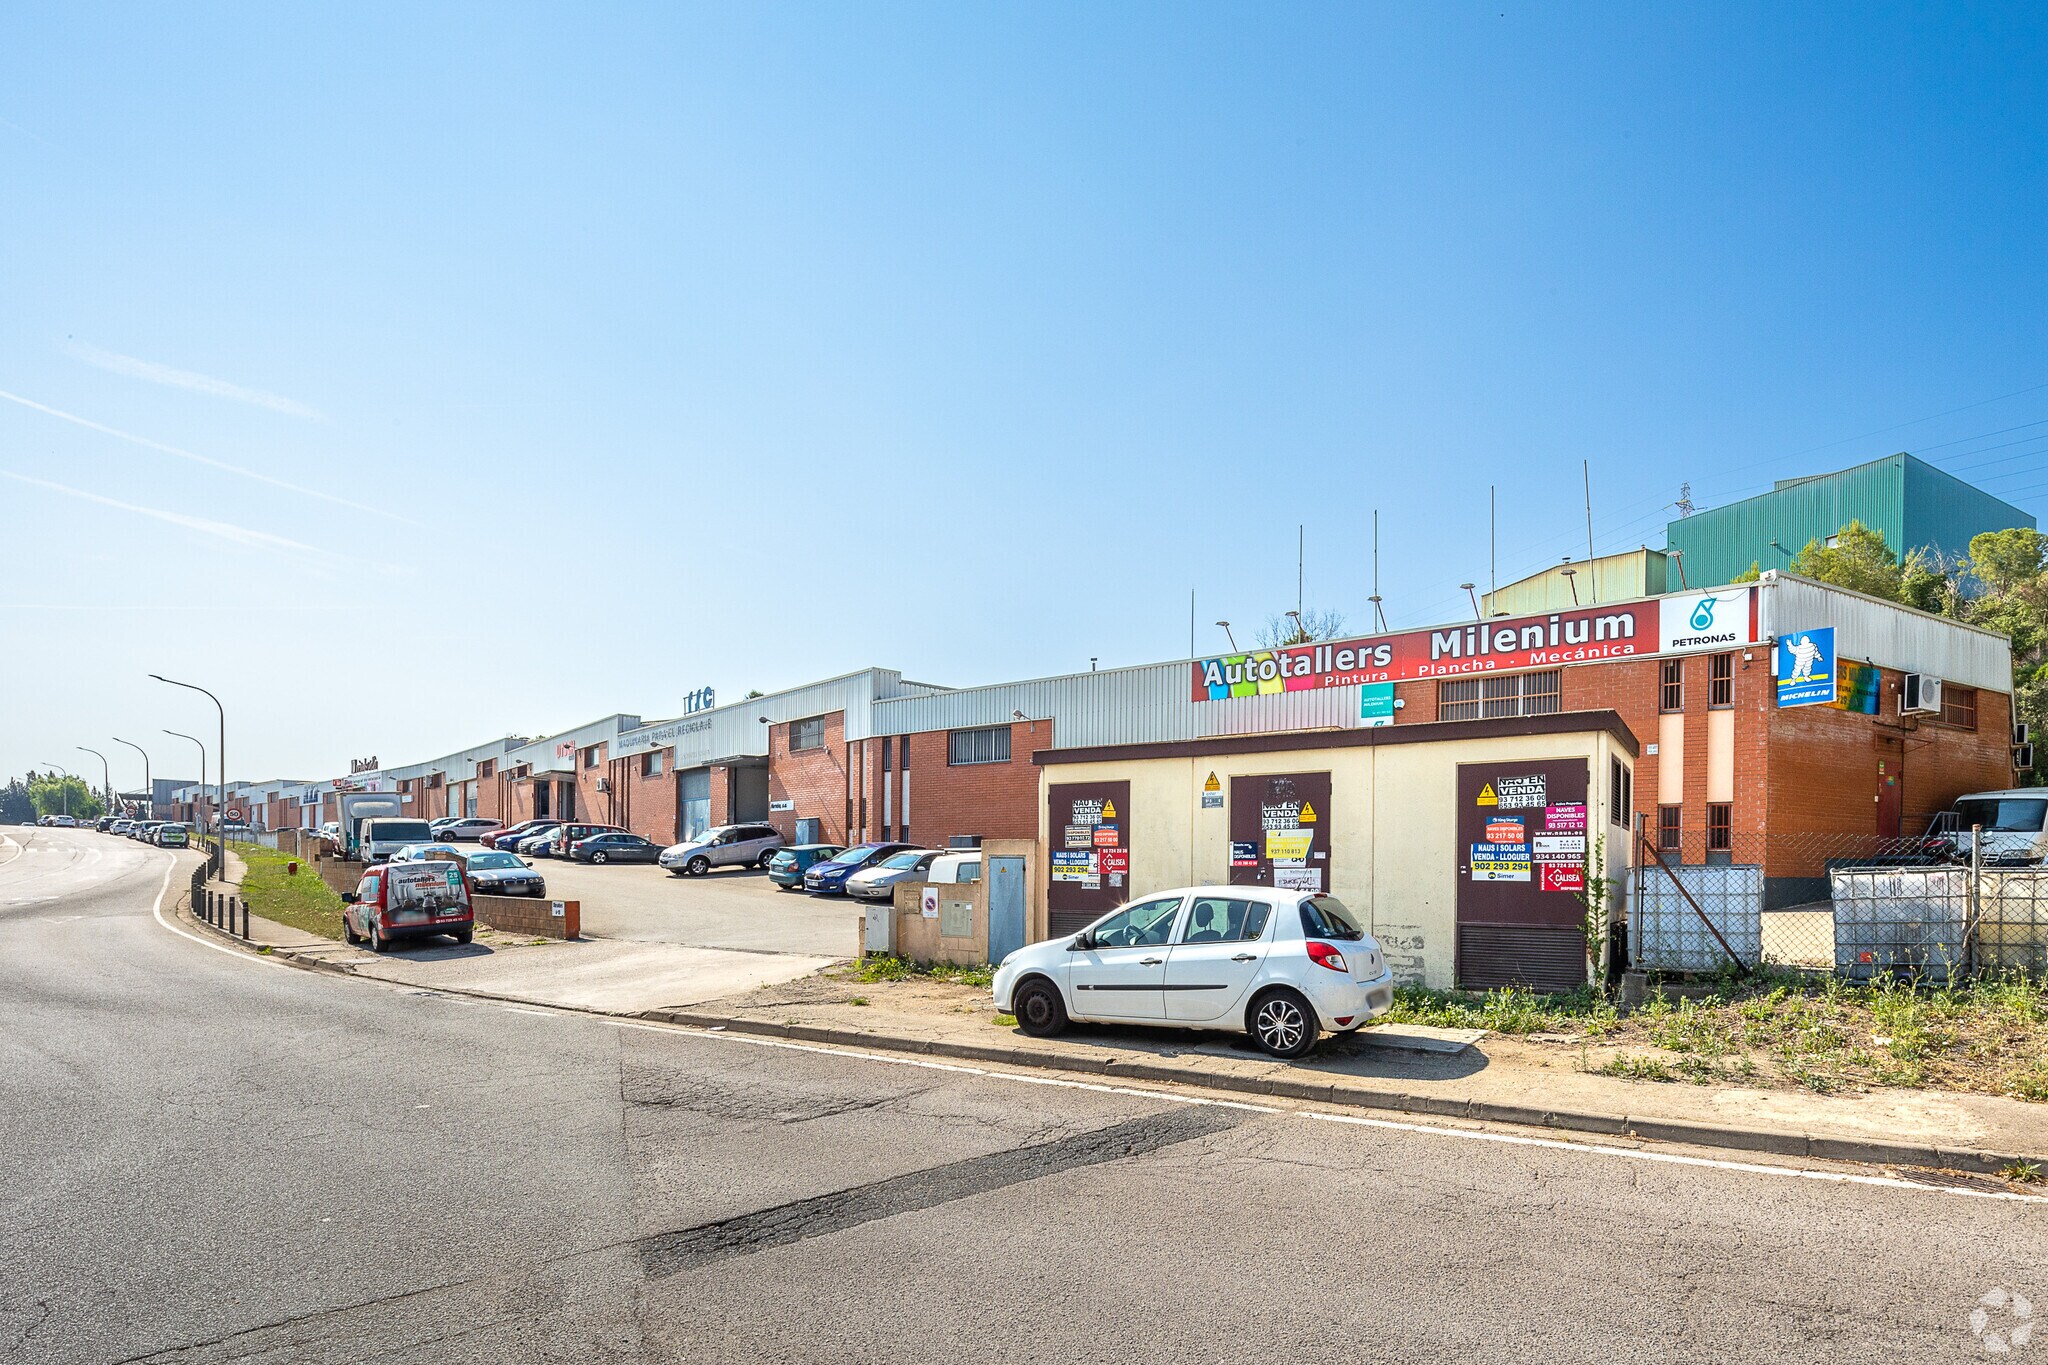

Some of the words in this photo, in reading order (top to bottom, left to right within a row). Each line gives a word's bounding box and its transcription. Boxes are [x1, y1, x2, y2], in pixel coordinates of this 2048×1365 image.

[1672, 633, 1736, 647] PETRONAS
[1203, 644, 1392, 687] Autotallers
[1431, 612, 1635, 660] Milenium
[1325, 672, 1388, 687] Pintura
[1418, 659, 1496, 677] Plancha
[1530, 644, 1635, 665] Mecánica
[1779, 688, 1831, 702] MICHELIN
[1500, 786, 1544, 794] VENDA
